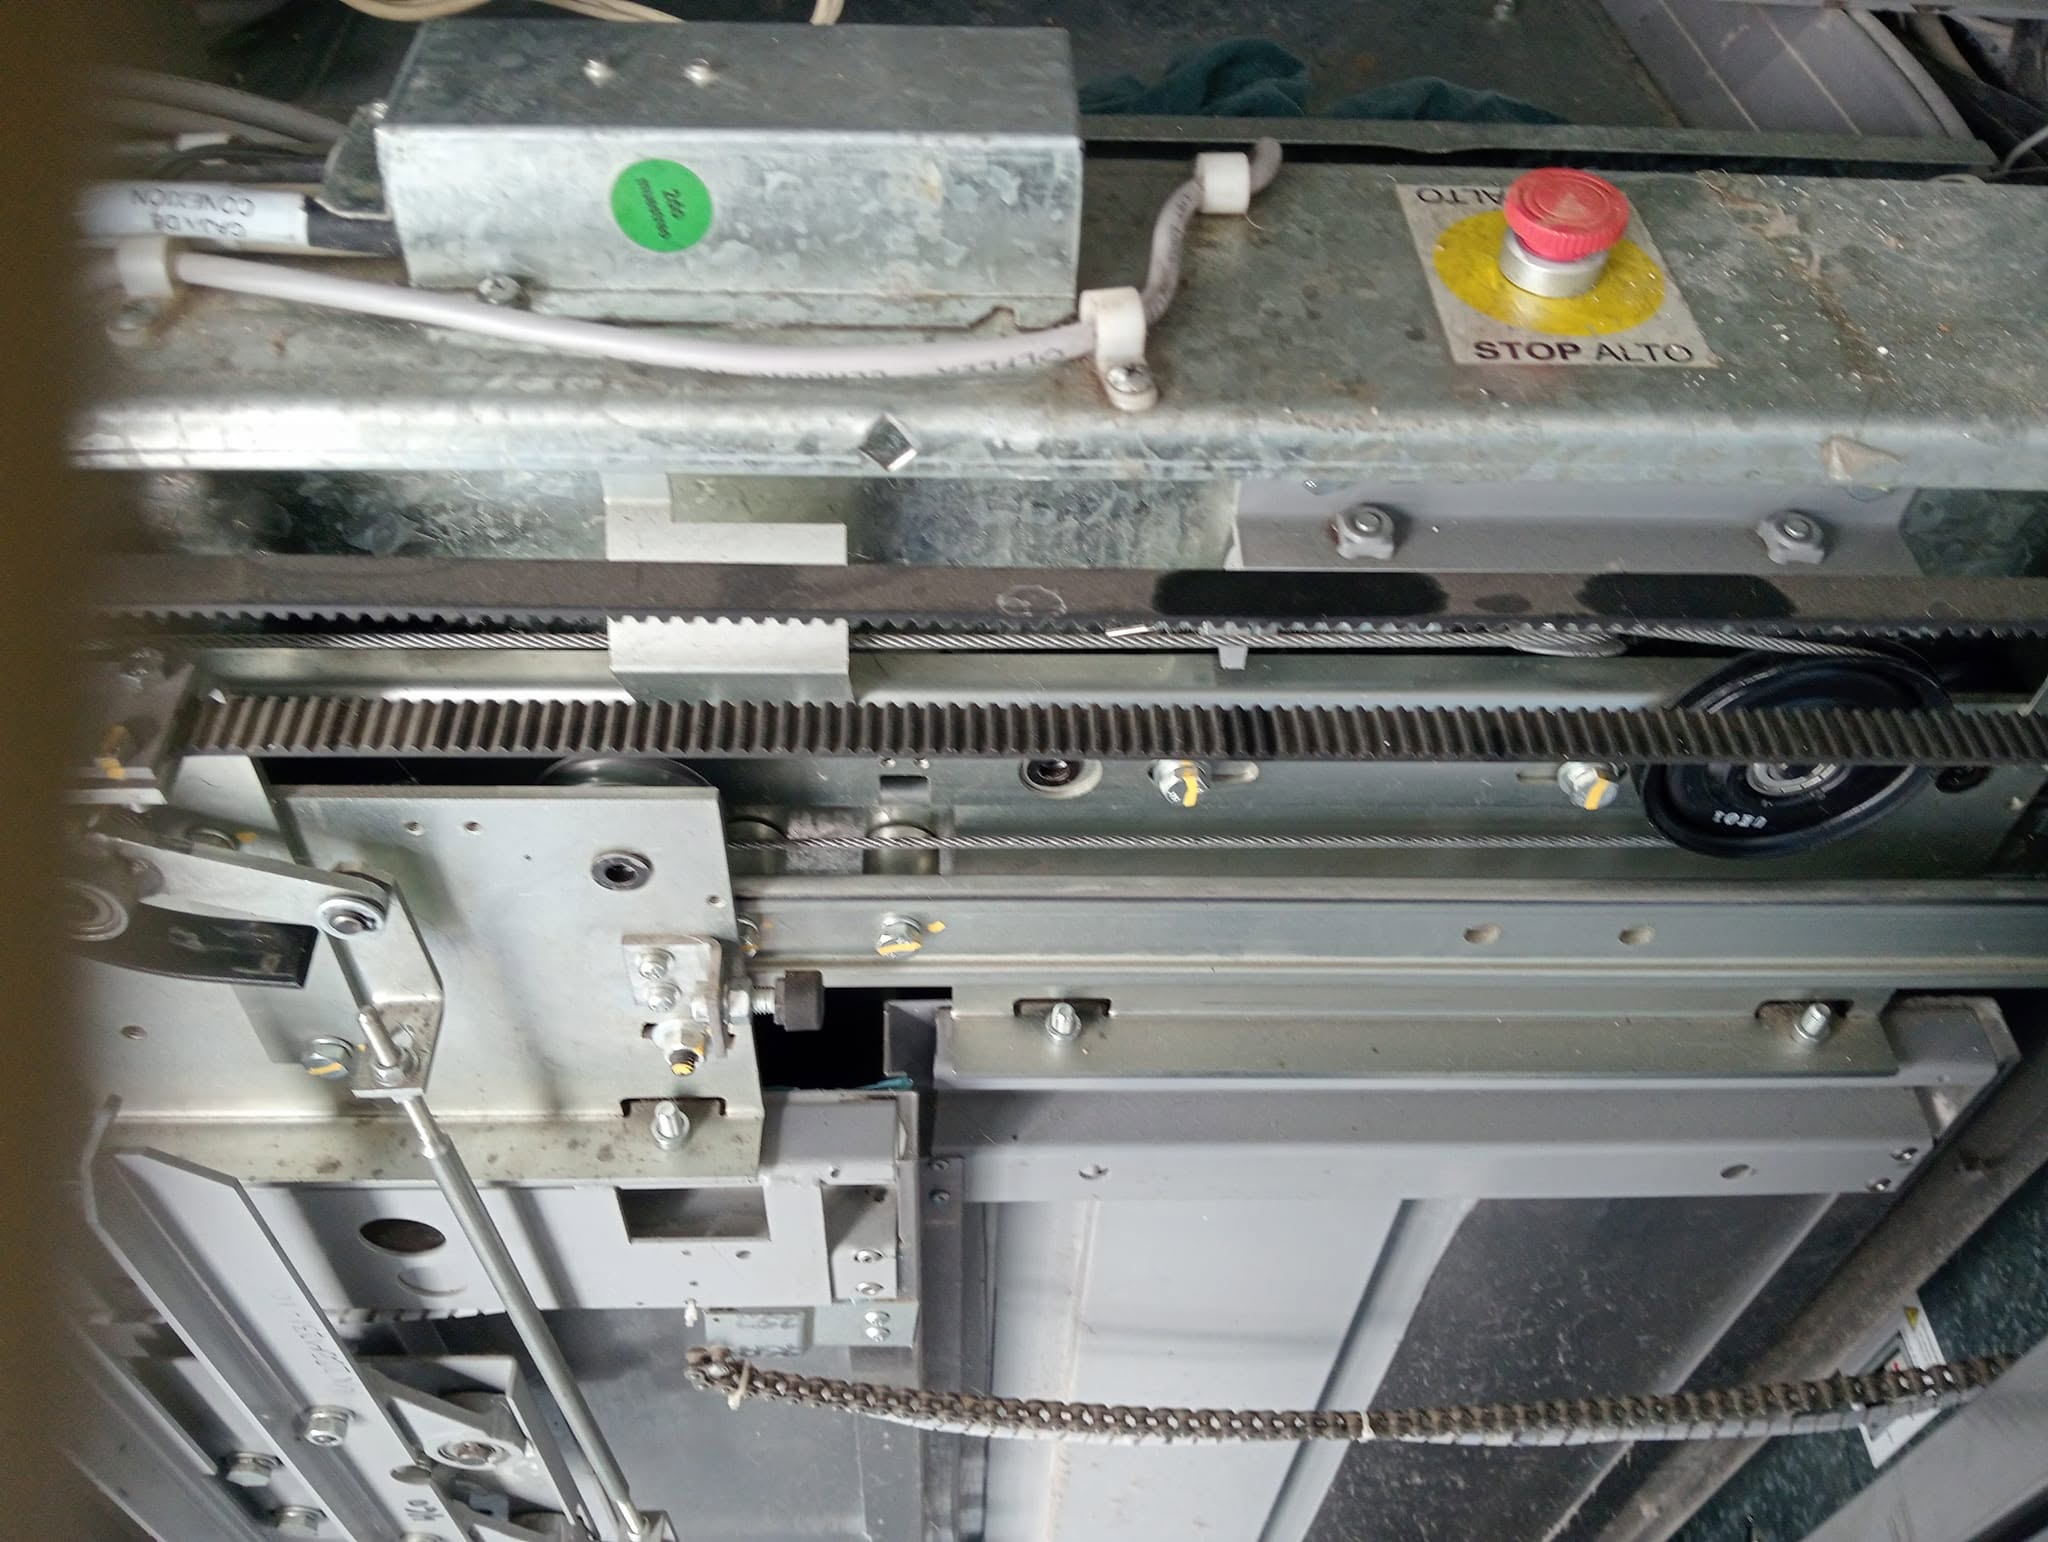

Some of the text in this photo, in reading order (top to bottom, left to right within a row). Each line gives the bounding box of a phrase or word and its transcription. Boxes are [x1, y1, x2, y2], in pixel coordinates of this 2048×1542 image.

[1415, 187, 1505, 206] ALTO
[1474, 341, 1695, 363] STOP ALTO
